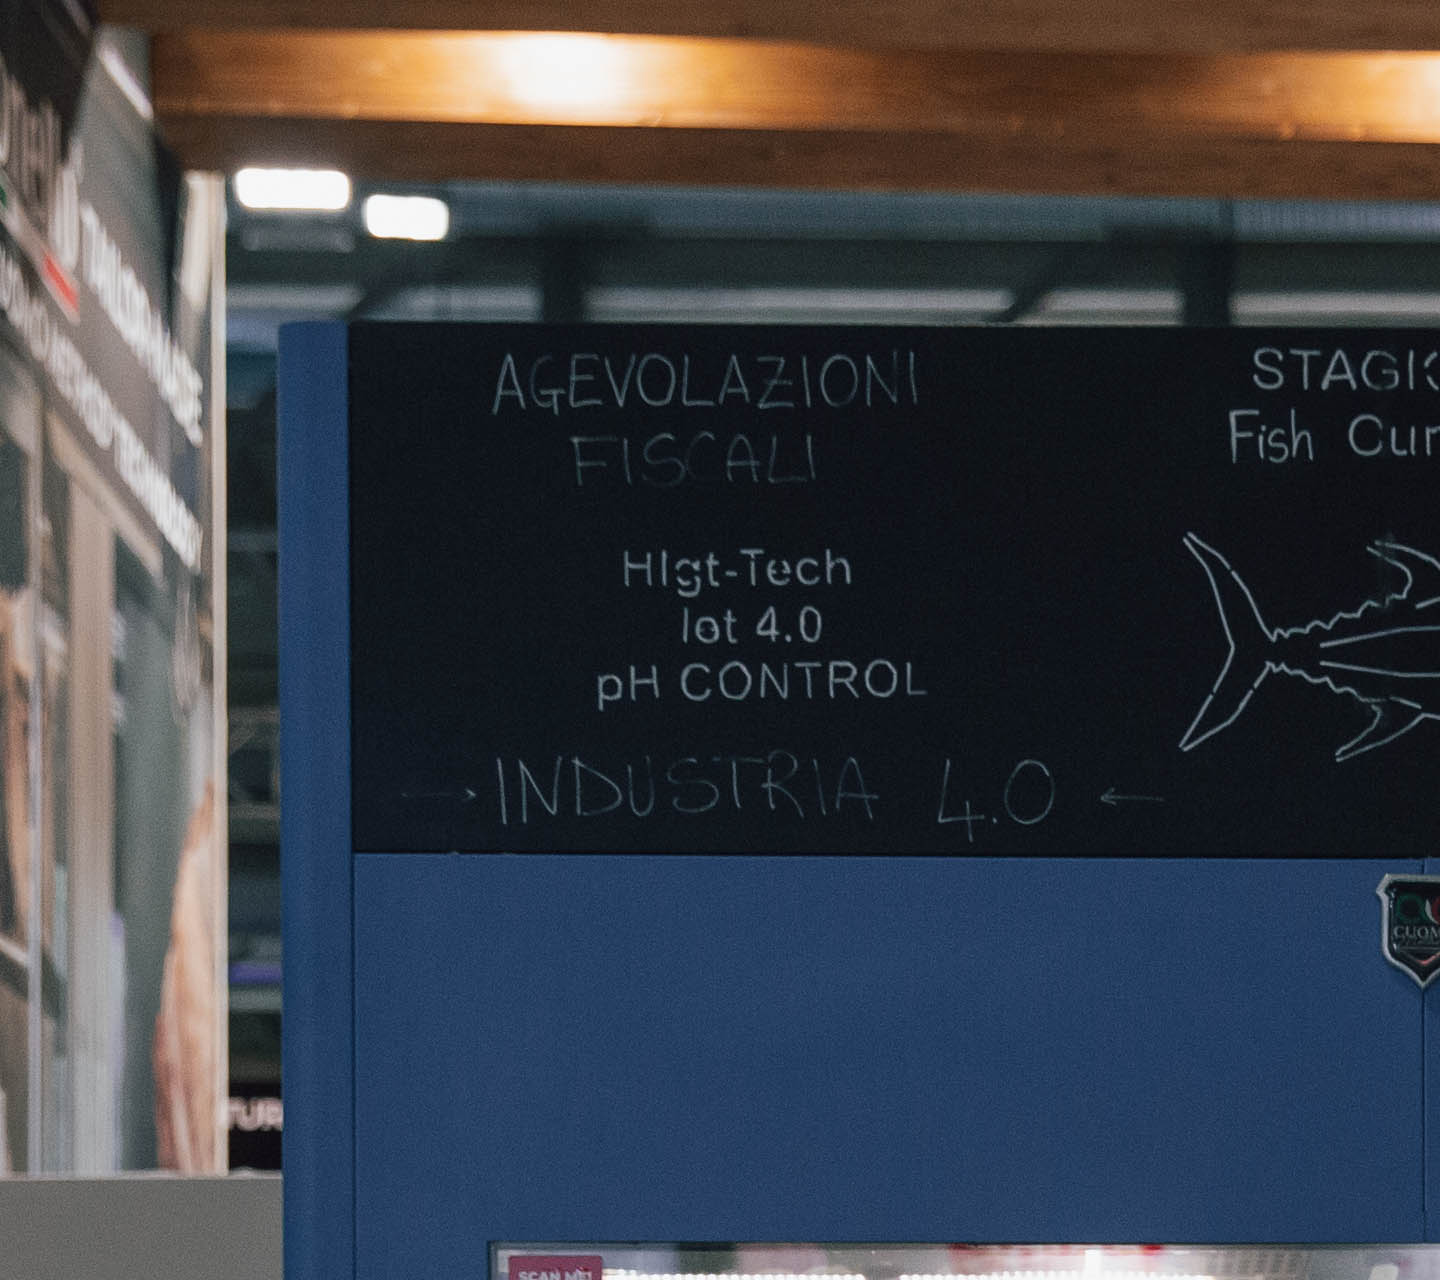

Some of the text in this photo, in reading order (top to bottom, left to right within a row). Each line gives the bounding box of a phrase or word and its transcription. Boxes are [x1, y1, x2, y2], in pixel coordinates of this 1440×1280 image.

[492, 350, 919, 416] AGEVOLAZIONI
[569, 432, 817, 486] FISCALI
[1228, 407, 1315, 464] Fish
[755, 605, 823, 643] 4.0
[597, 660, 928, 711] pH CONTROL
[495, 749, 1057, 843] INDUSTRIA 4.0
